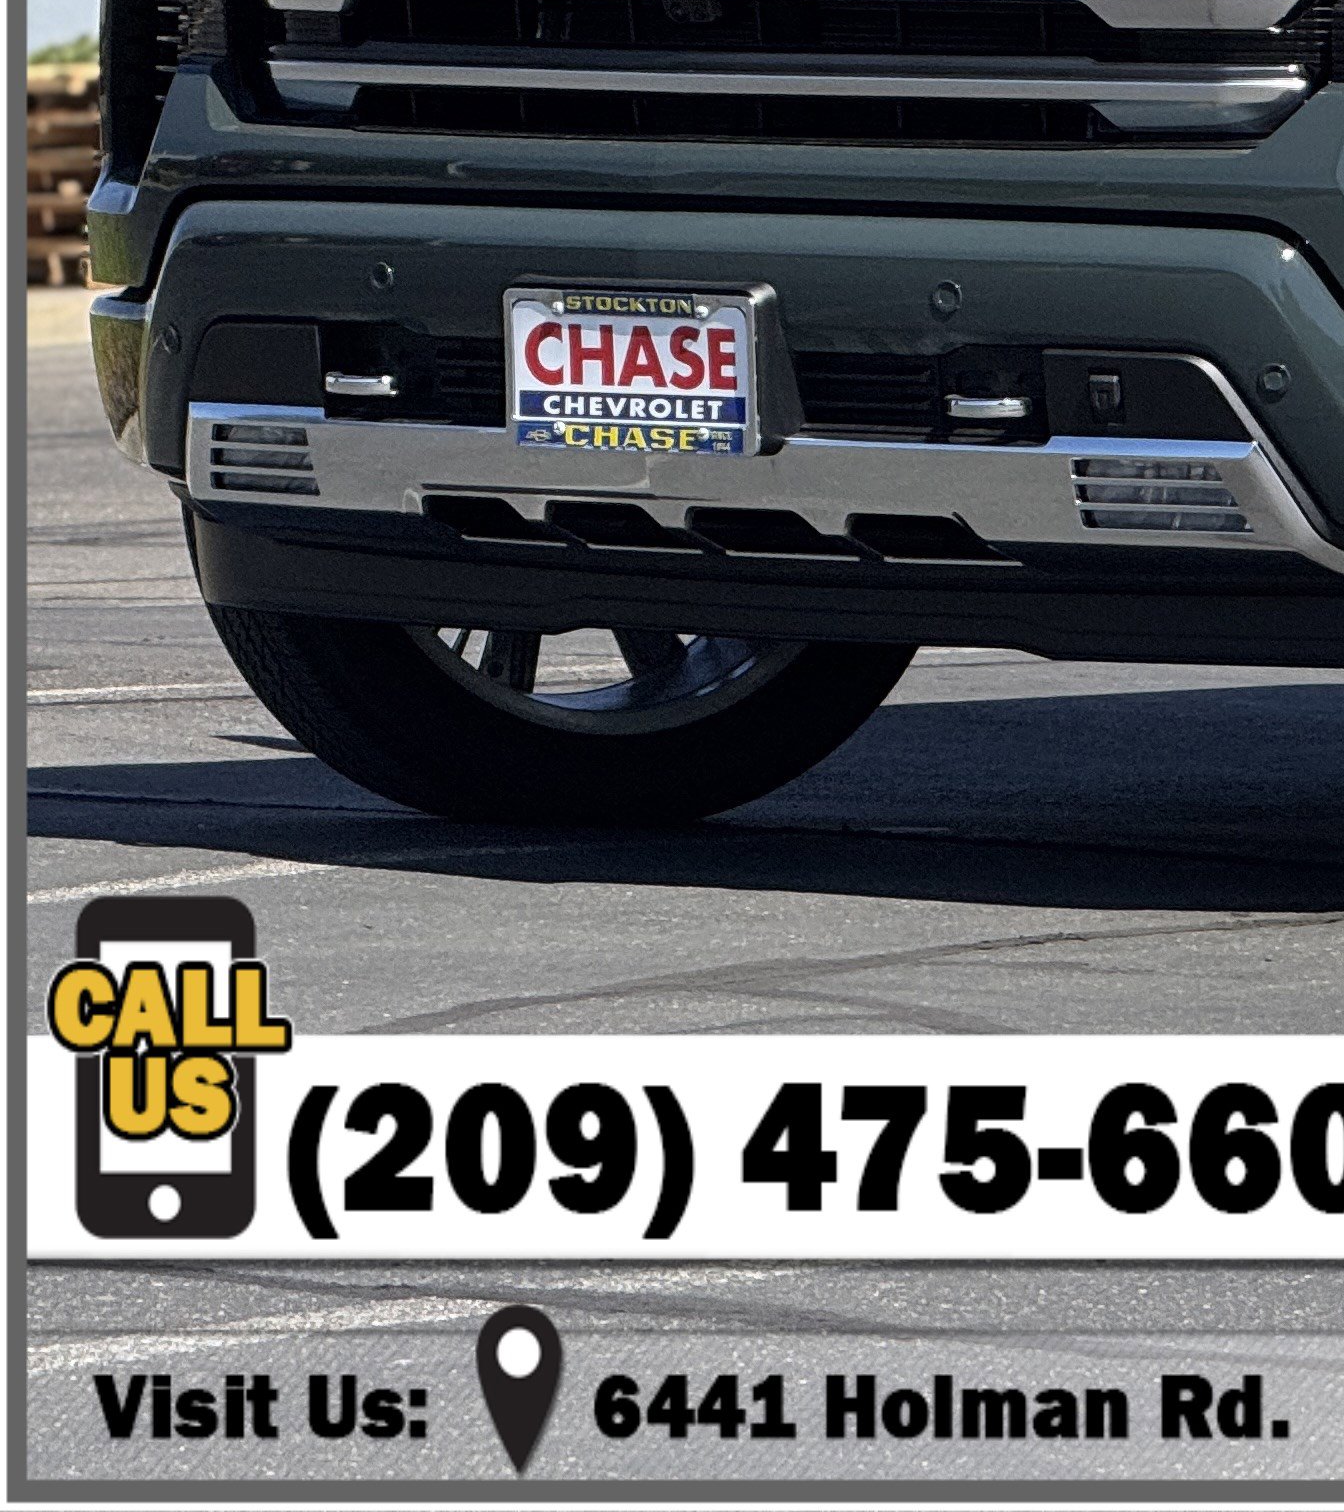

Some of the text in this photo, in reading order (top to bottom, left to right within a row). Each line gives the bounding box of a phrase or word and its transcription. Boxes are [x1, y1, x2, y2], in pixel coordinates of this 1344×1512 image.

[566, 296, 693, 314] STOCKTON
[524, 321, 738, 391] CHASE
[543, 395, 723, 420] CHEVROLET
[564, 425, 701, 450] CHASE
